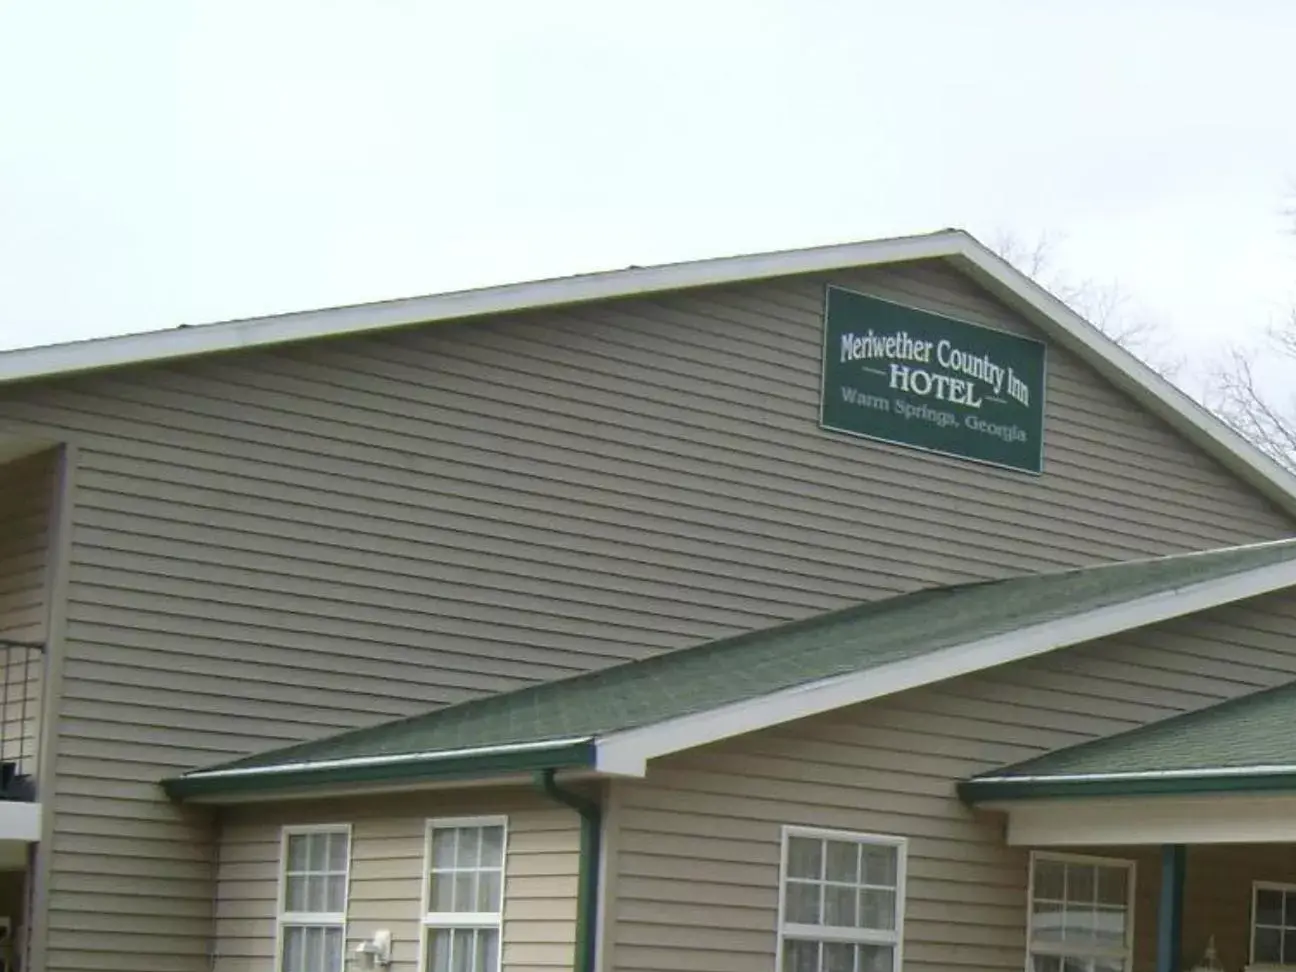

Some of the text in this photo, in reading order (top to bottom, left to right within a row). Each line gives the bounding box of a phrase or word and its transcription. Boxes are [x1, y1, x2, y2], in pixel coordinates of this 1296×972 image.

[840, 329, 1030, 408] Meriwether Country Inn
[889, 363, 982, 409] HOTEL
[841, 386, 1028, 442] Warm Springs, Georgia
